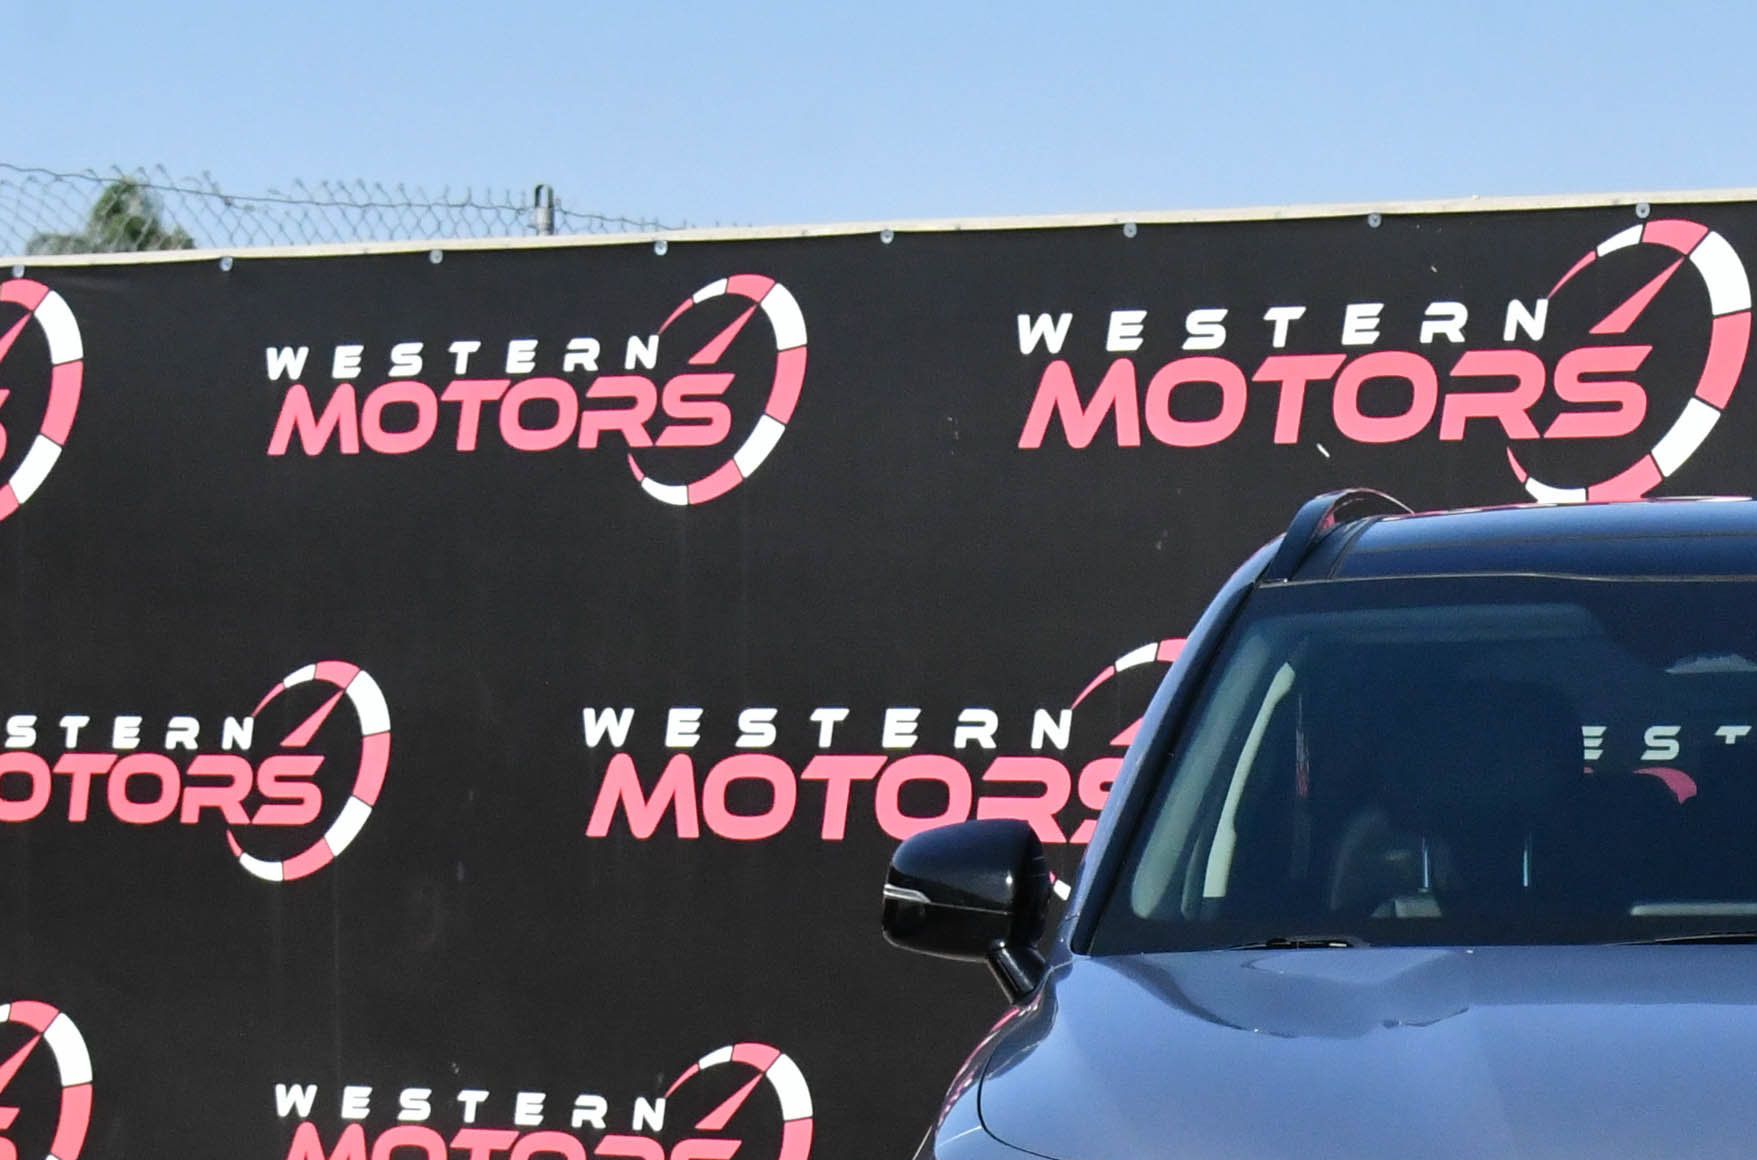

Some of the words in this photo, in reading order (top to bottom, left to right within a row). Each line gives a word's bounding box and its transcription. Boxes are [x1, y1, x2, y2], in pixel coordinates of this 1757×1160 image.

[1017, 298, 1549, 355] WESTERN
[266, 334, 660, 381] WESTERN
[267, 372, 735, 456] MOTORS
[1019, 345, 1653, 449] MOTORS
[582, 707, 1073, 750] WESTERN
[275, 1083, 666, 1132] WESTERN
